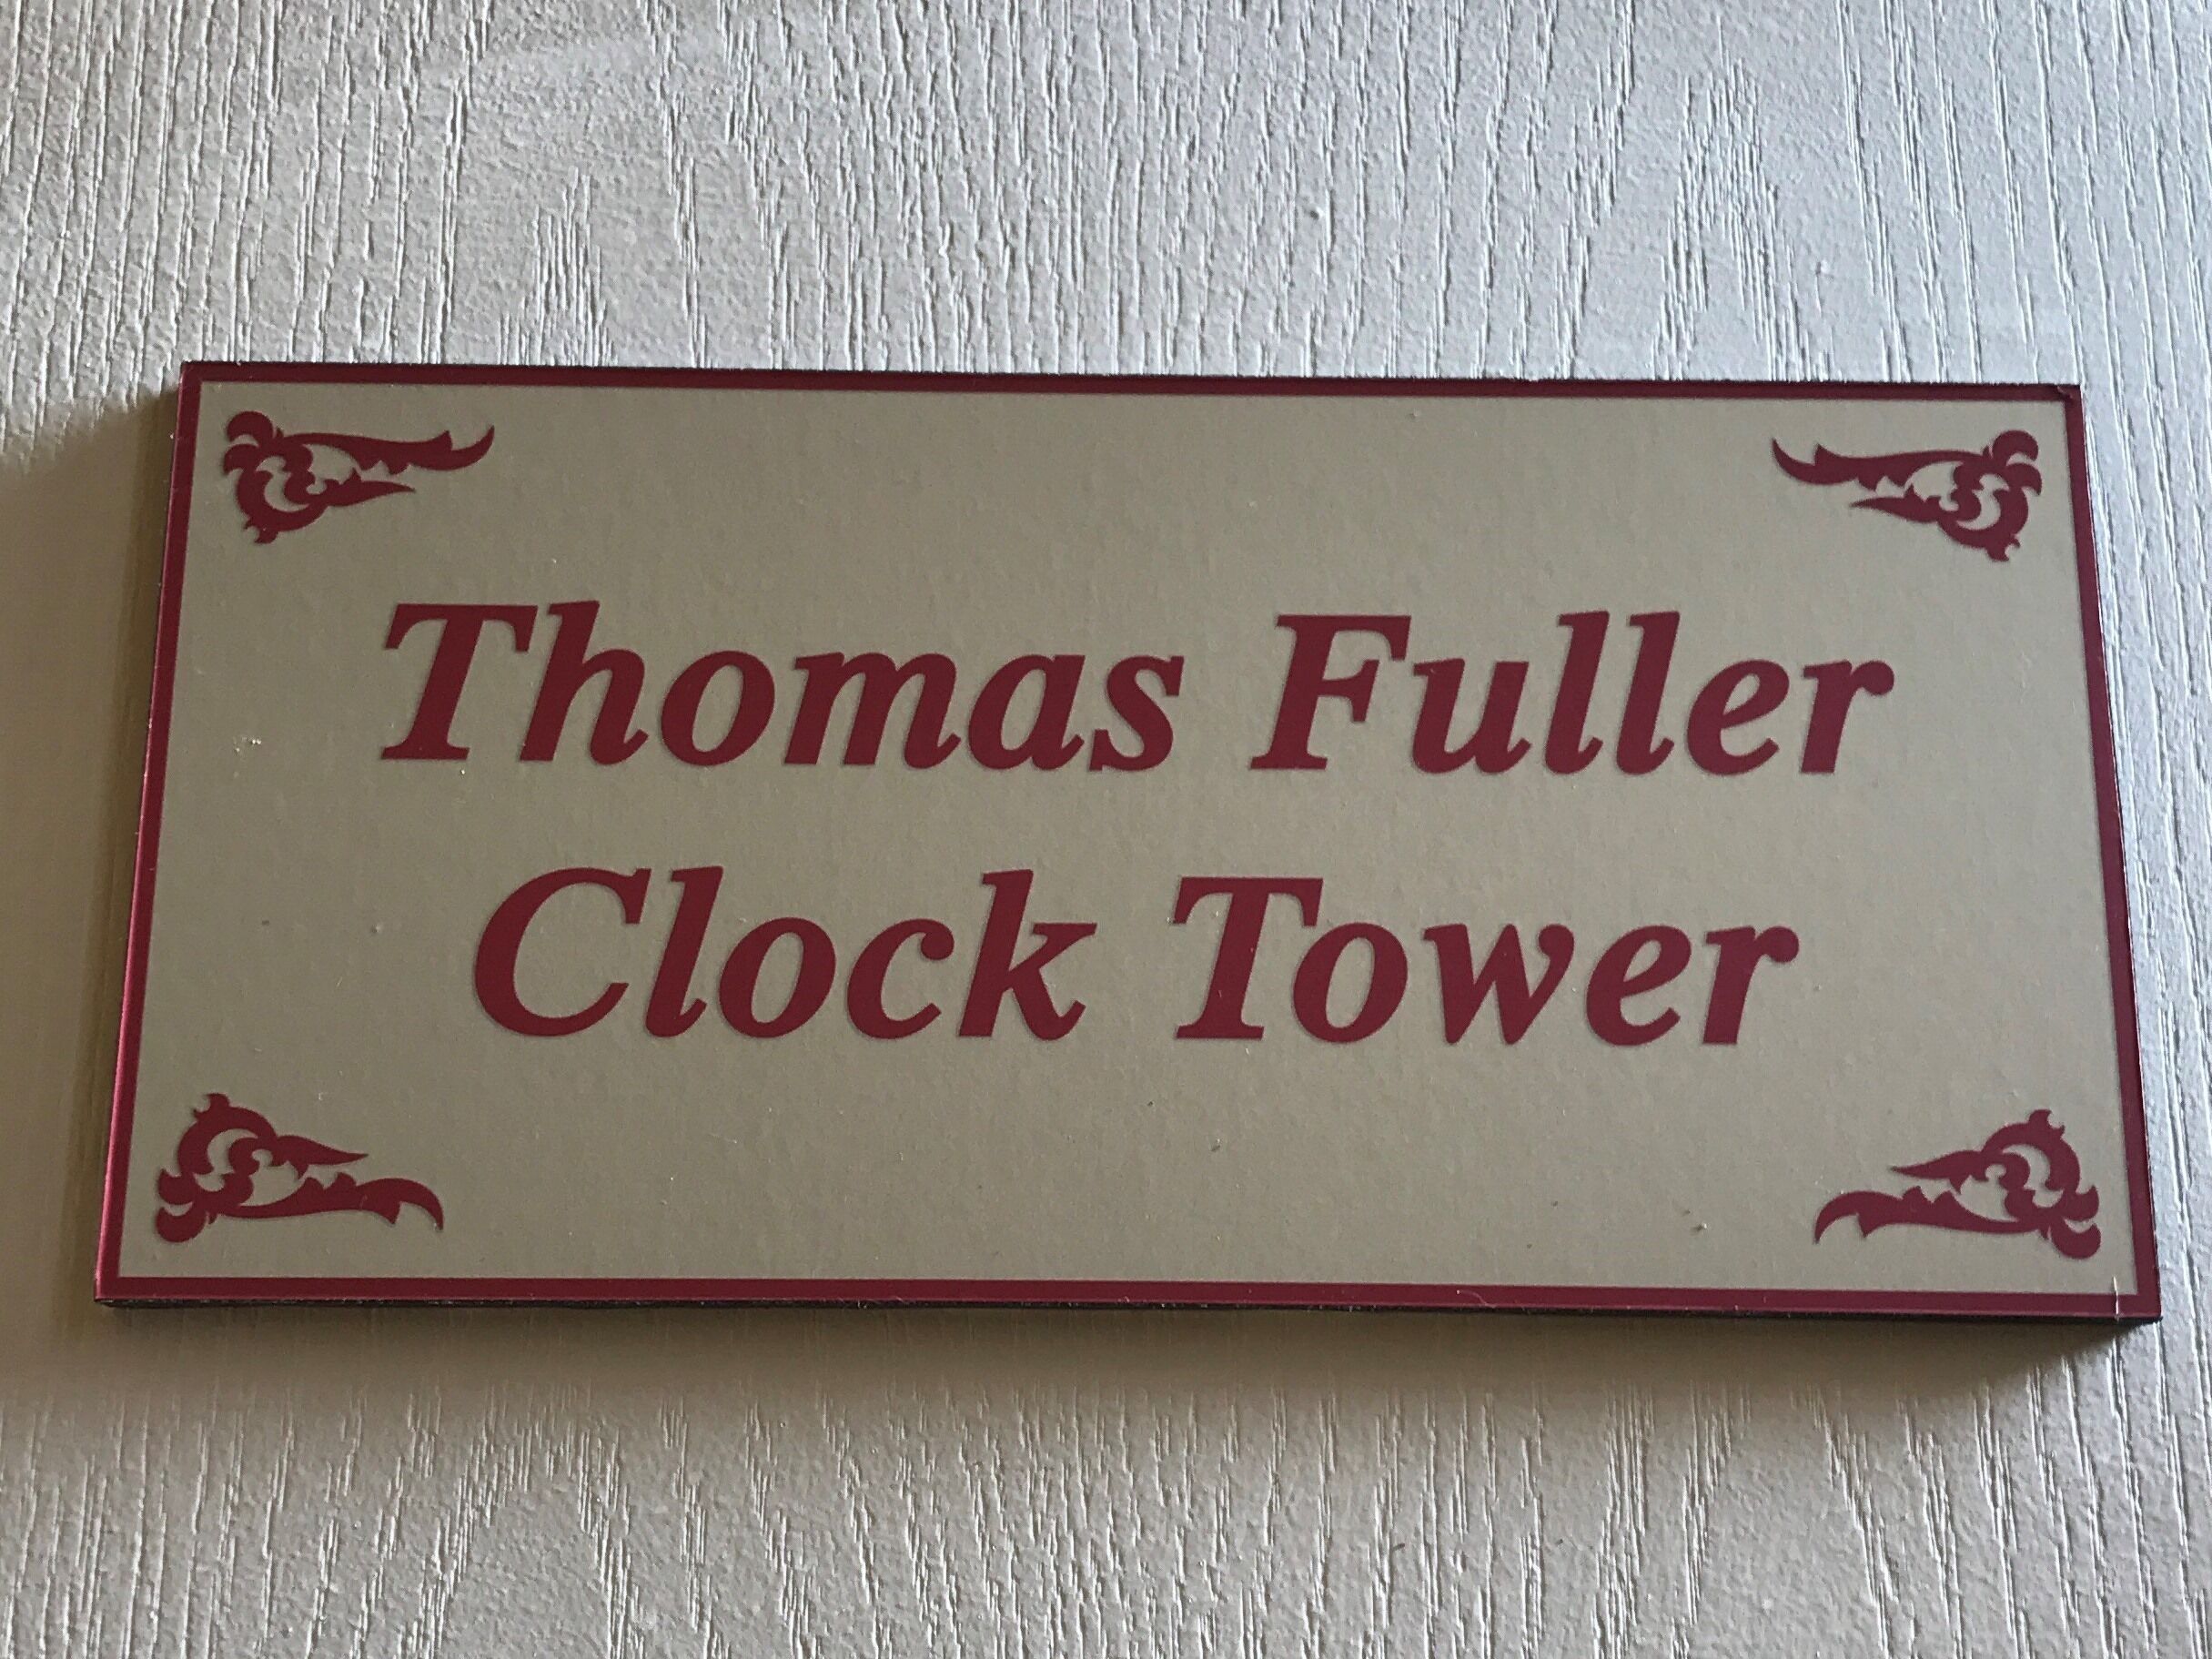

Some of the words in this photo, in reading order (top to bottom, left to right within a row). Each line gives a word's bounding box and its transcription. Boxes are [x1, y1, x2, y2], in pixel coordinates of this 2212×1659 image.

[384, 602, 1184, 771] Thomas
[1252, 612, 1894, 774] Fuller
[475, 866, 1096, 1039] Clock
[1175, 877, 1799, 1046] Tower
